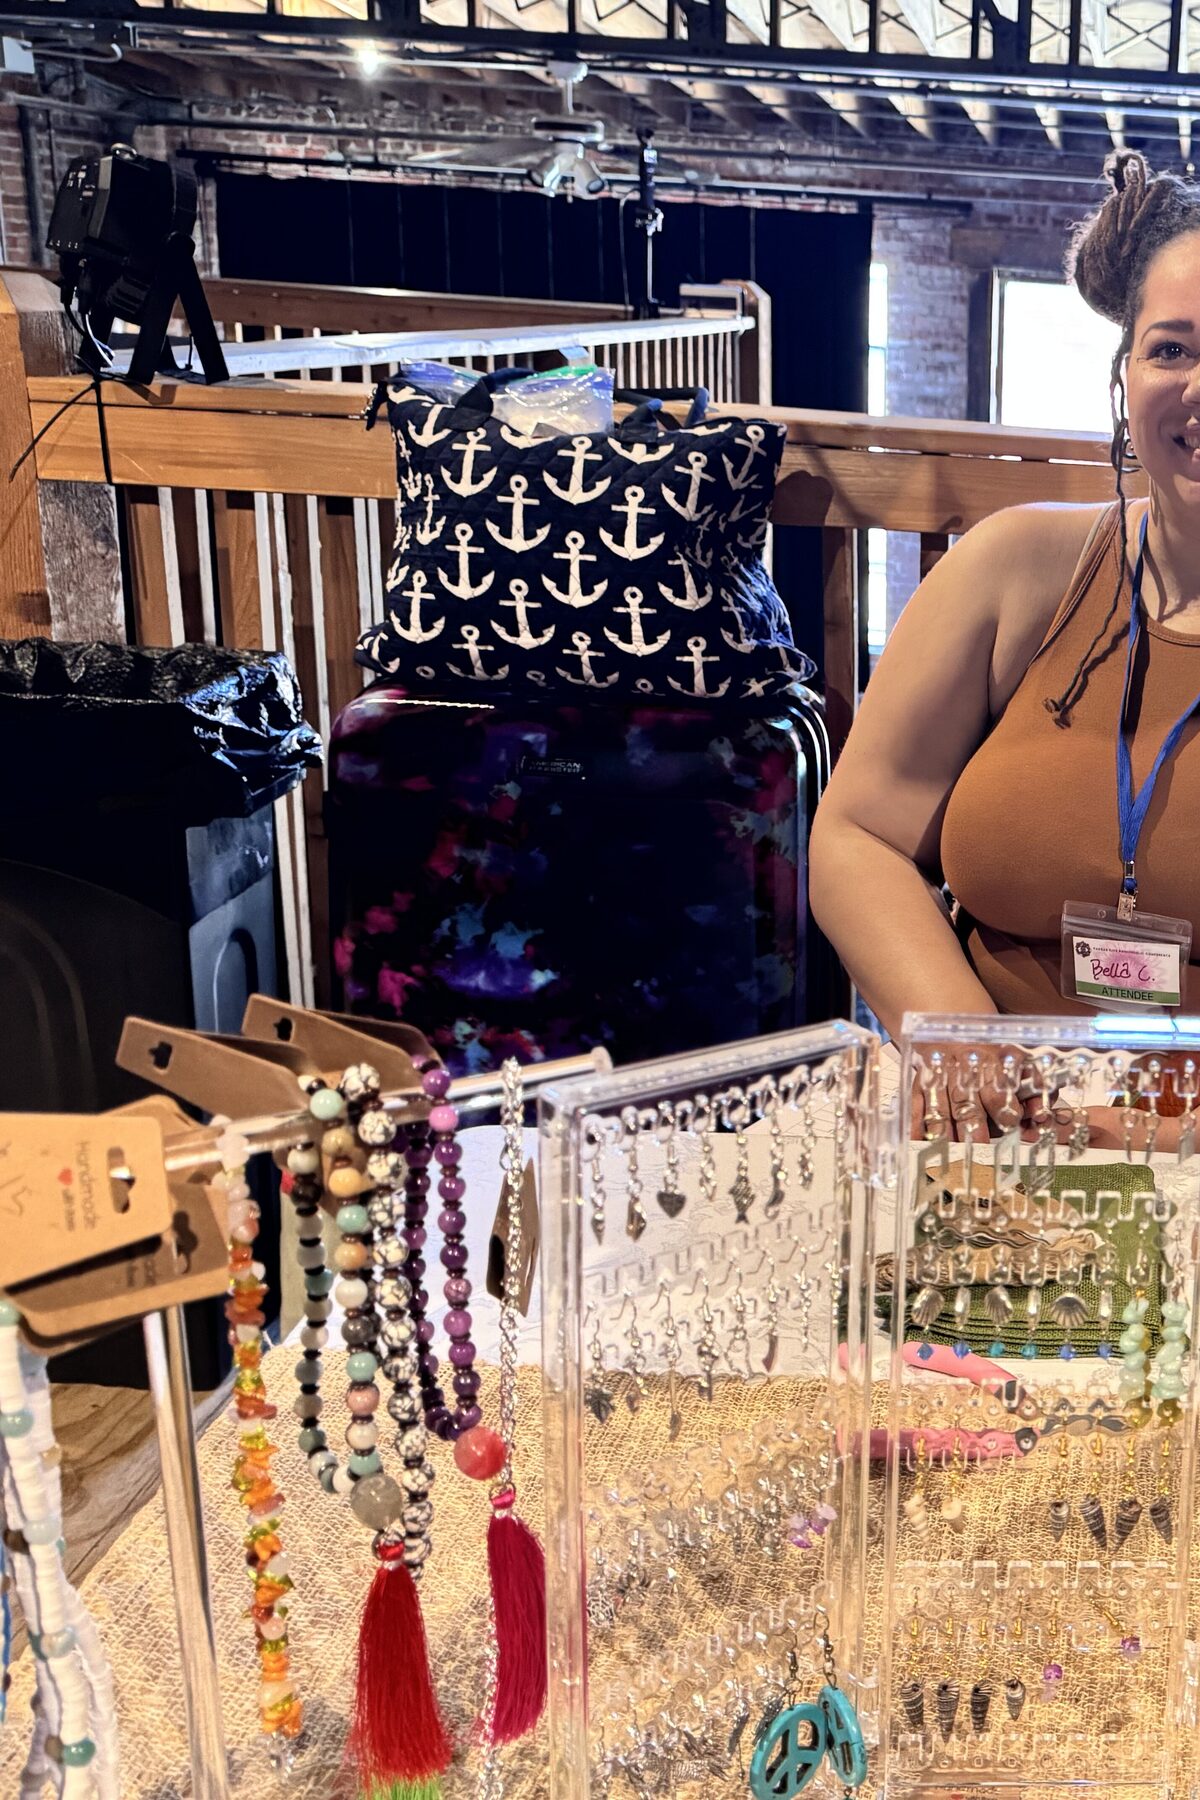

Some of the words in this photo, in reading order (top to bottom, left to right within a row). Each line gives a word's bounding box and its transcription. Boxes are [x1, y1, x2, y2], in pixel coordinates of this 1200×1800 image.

[1090, 958, 1131, 980] Bella
[1138, 965, 1155, 982] C.
[1102, 986, 1154, 1001] ATTENDEE
